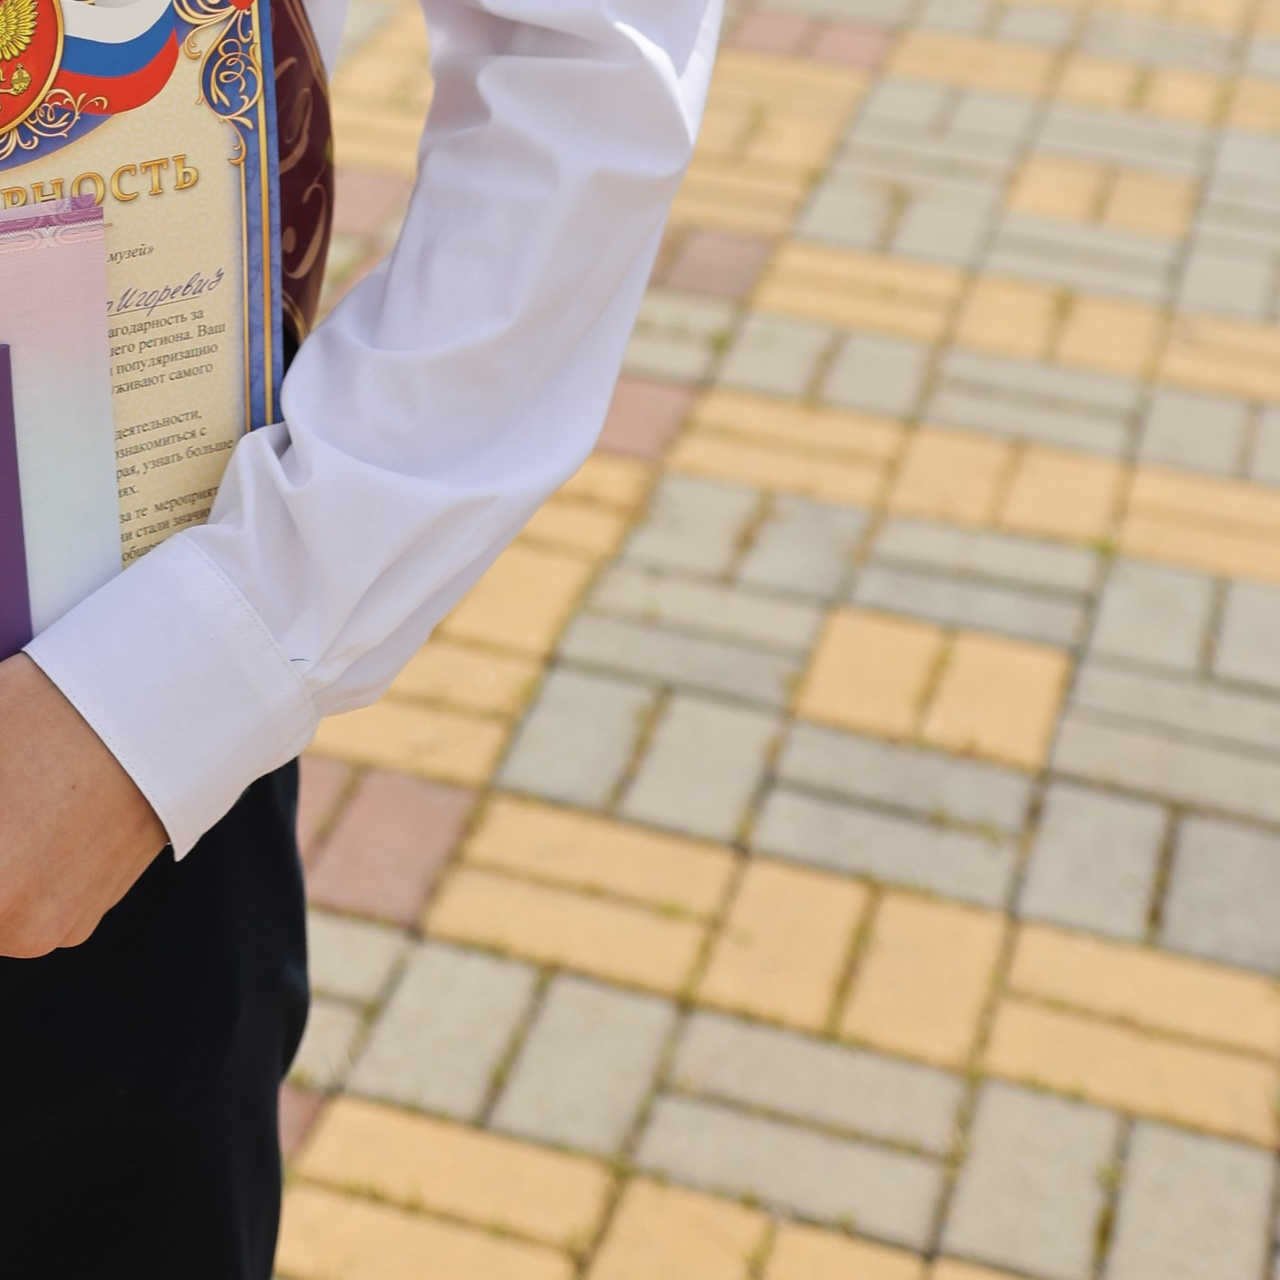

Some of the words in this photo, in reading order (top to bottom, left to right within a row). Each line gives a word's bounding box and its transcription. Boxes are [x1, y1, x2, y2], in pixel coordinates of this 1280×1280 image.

[116, 267, 225, 317] Игоревич
[108, 312, 187, 339] агодарность
[190, 309, 204, 321] за
[138, 331, 193, 354] региона.
[197, 323, 226, 338] Ваш
[116, 343, 218, 375] популяризацию
[168, 362, 213, 381] самого
[114, 410, 203, 441] деятельности,
[199, 426, 207, 437] с
[116, 464, 140, 483] рая,
[143, 452, 184, 474] узнать
[185, 439, 234, 459] больше
[153, 486, 218, 513] мероприят
[135, 519, 170, 538] стали
